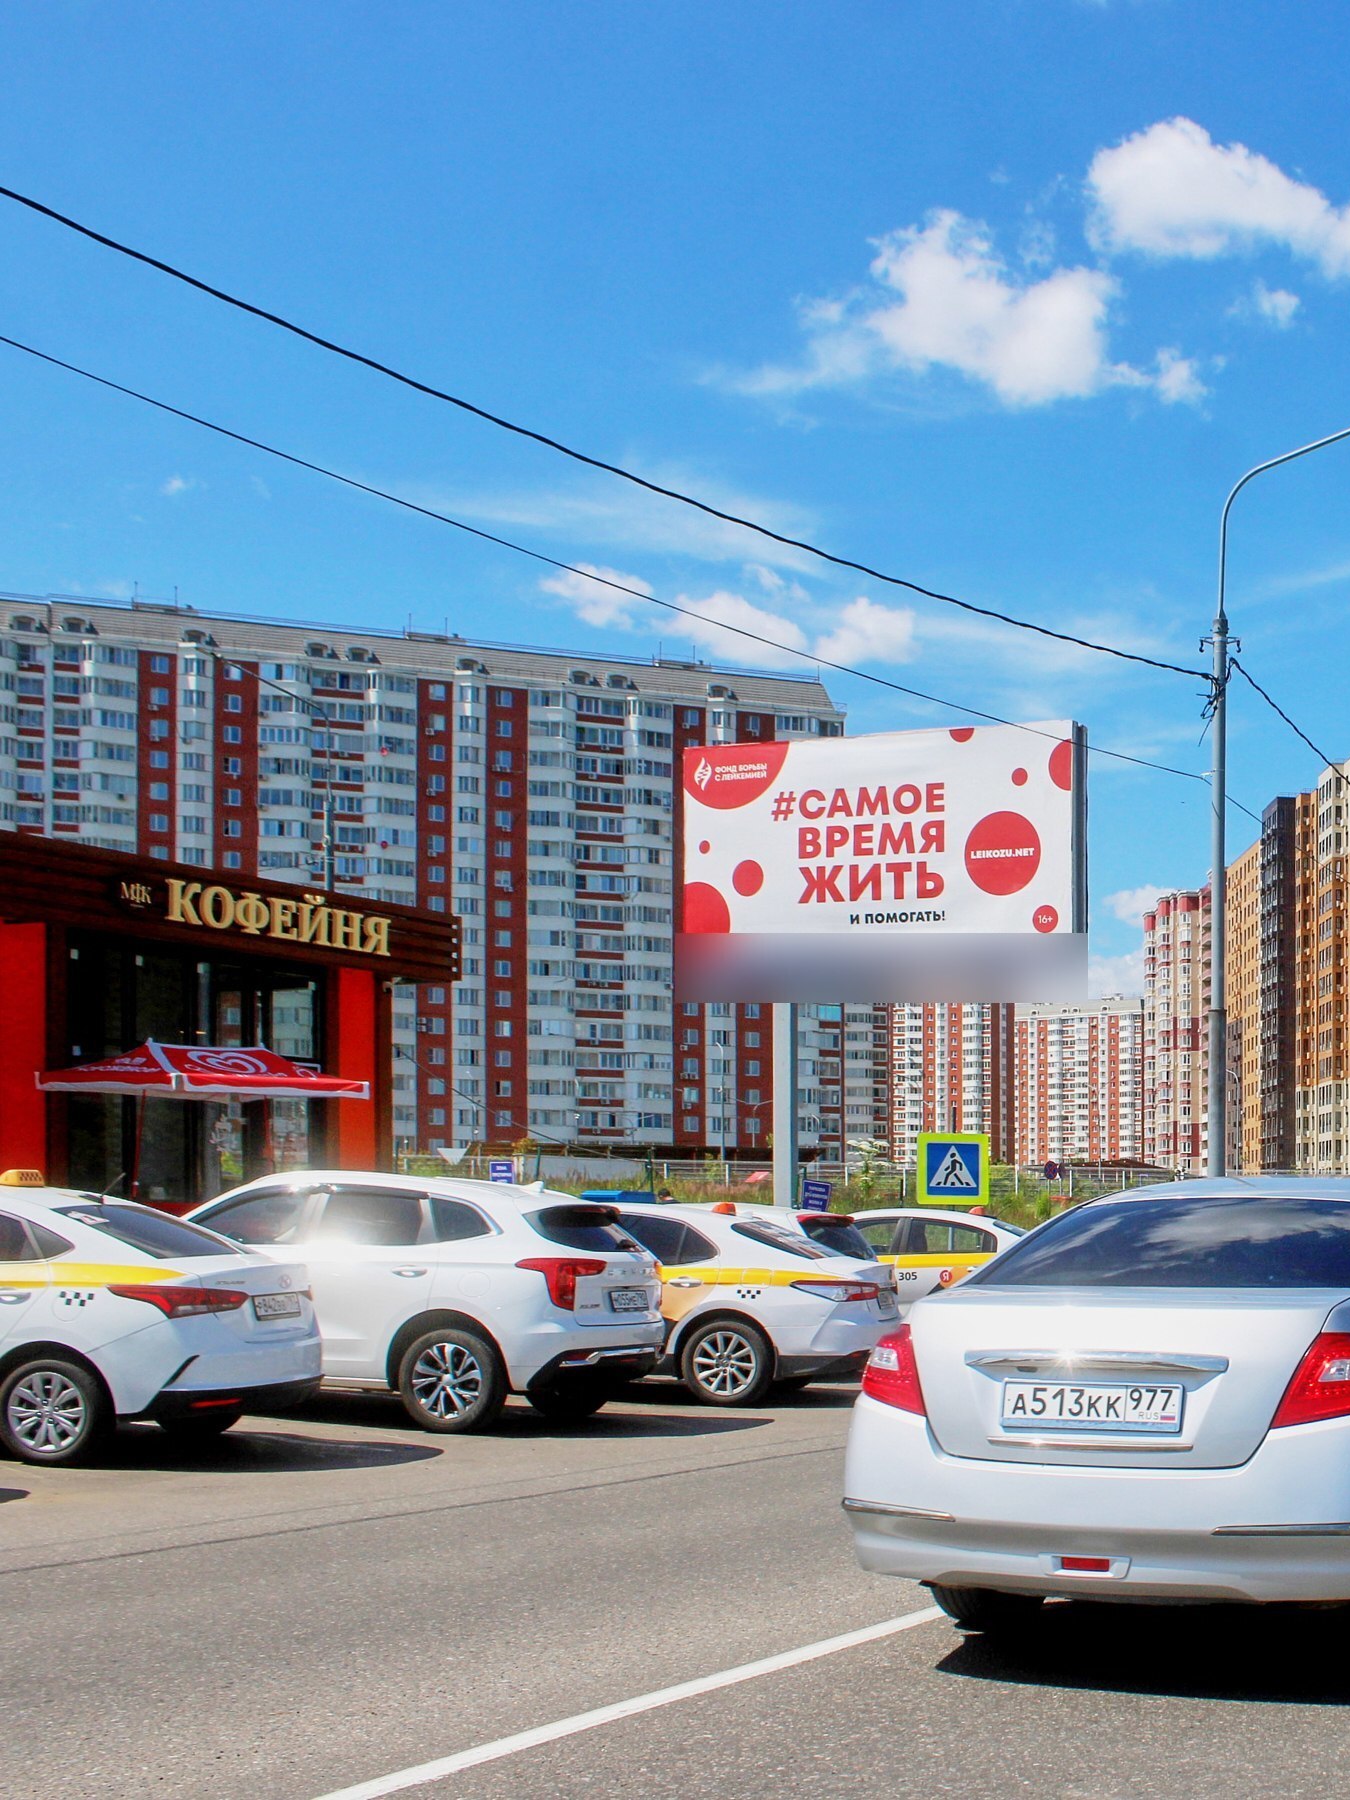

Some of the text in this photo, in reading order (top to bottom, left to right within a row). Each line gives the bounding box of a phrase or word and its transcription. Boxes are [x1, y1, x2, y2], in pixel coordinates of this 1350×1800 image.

[714, 763, 768, 773] ФОНД БОРЬБЫ
[714, 771, 767, 782] С ЛЕЙКЕМИЕЙ
[771, 782, 945, 821] #САМОЕ
[798, 820, 945, 859] ВРЕМЯ
[970, 848, 1035, 859] LEIKOZU.NET
[798, 861, 945, 904] ЖИТЬ
[165, 878, 391, 957] КОФЕЙНЯ
[850, 911, 946, 925] И ПОМОГАТЬ!
[1037, 914, 1053, 924] 16+
[898, 1271, 918, 1281] 305
[1012, 1387, 1173, 1419] А513КК 977
[1138, 1411, 1160, 1421] RUS
